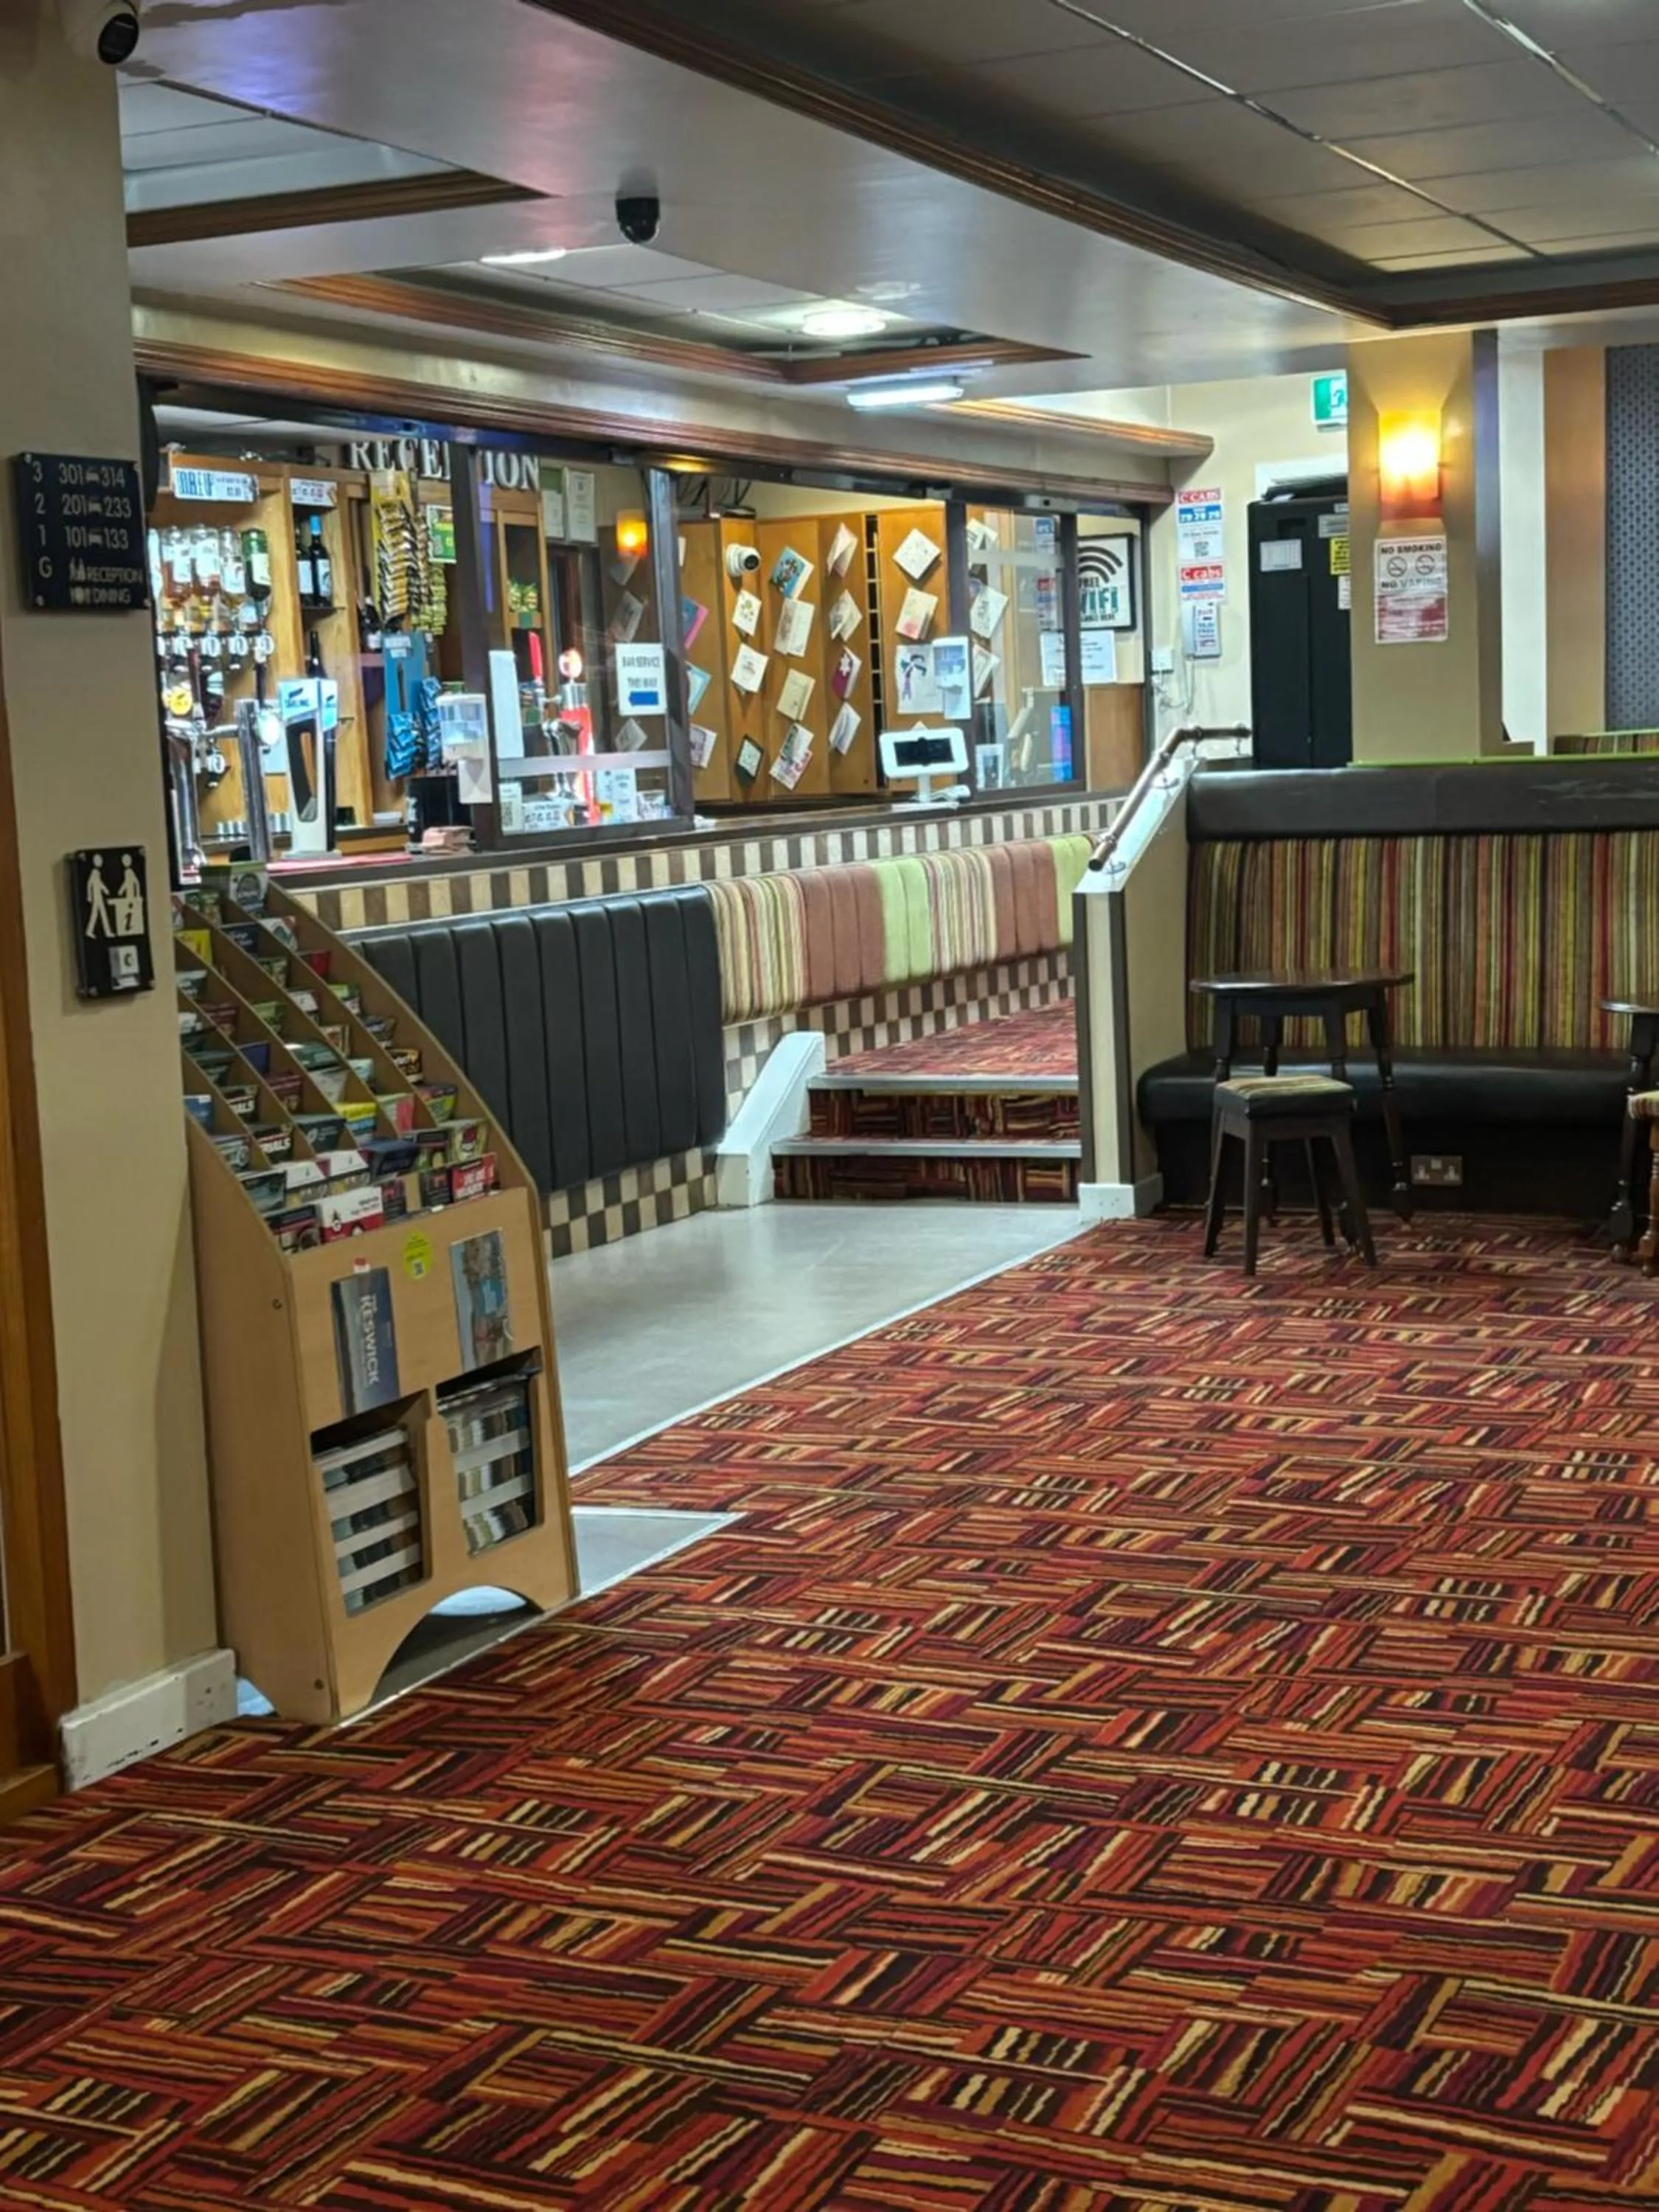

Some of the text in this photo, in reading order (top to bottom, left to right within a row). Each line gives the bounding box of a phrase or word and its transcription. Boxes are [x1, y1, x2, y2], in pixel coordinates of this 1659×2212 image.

[32, 462, 125, 489] 3 301 314
[350, 438, 540, 490] RECEION
[35, 495, 131, 517] 2 201 233
[38, 525, 128, 549] 1 101 133
[38, 557, 142, 583] G RECEPTION
[93, 588, 131, 603] DINING
[1381, 580, 1397, 588] NO
